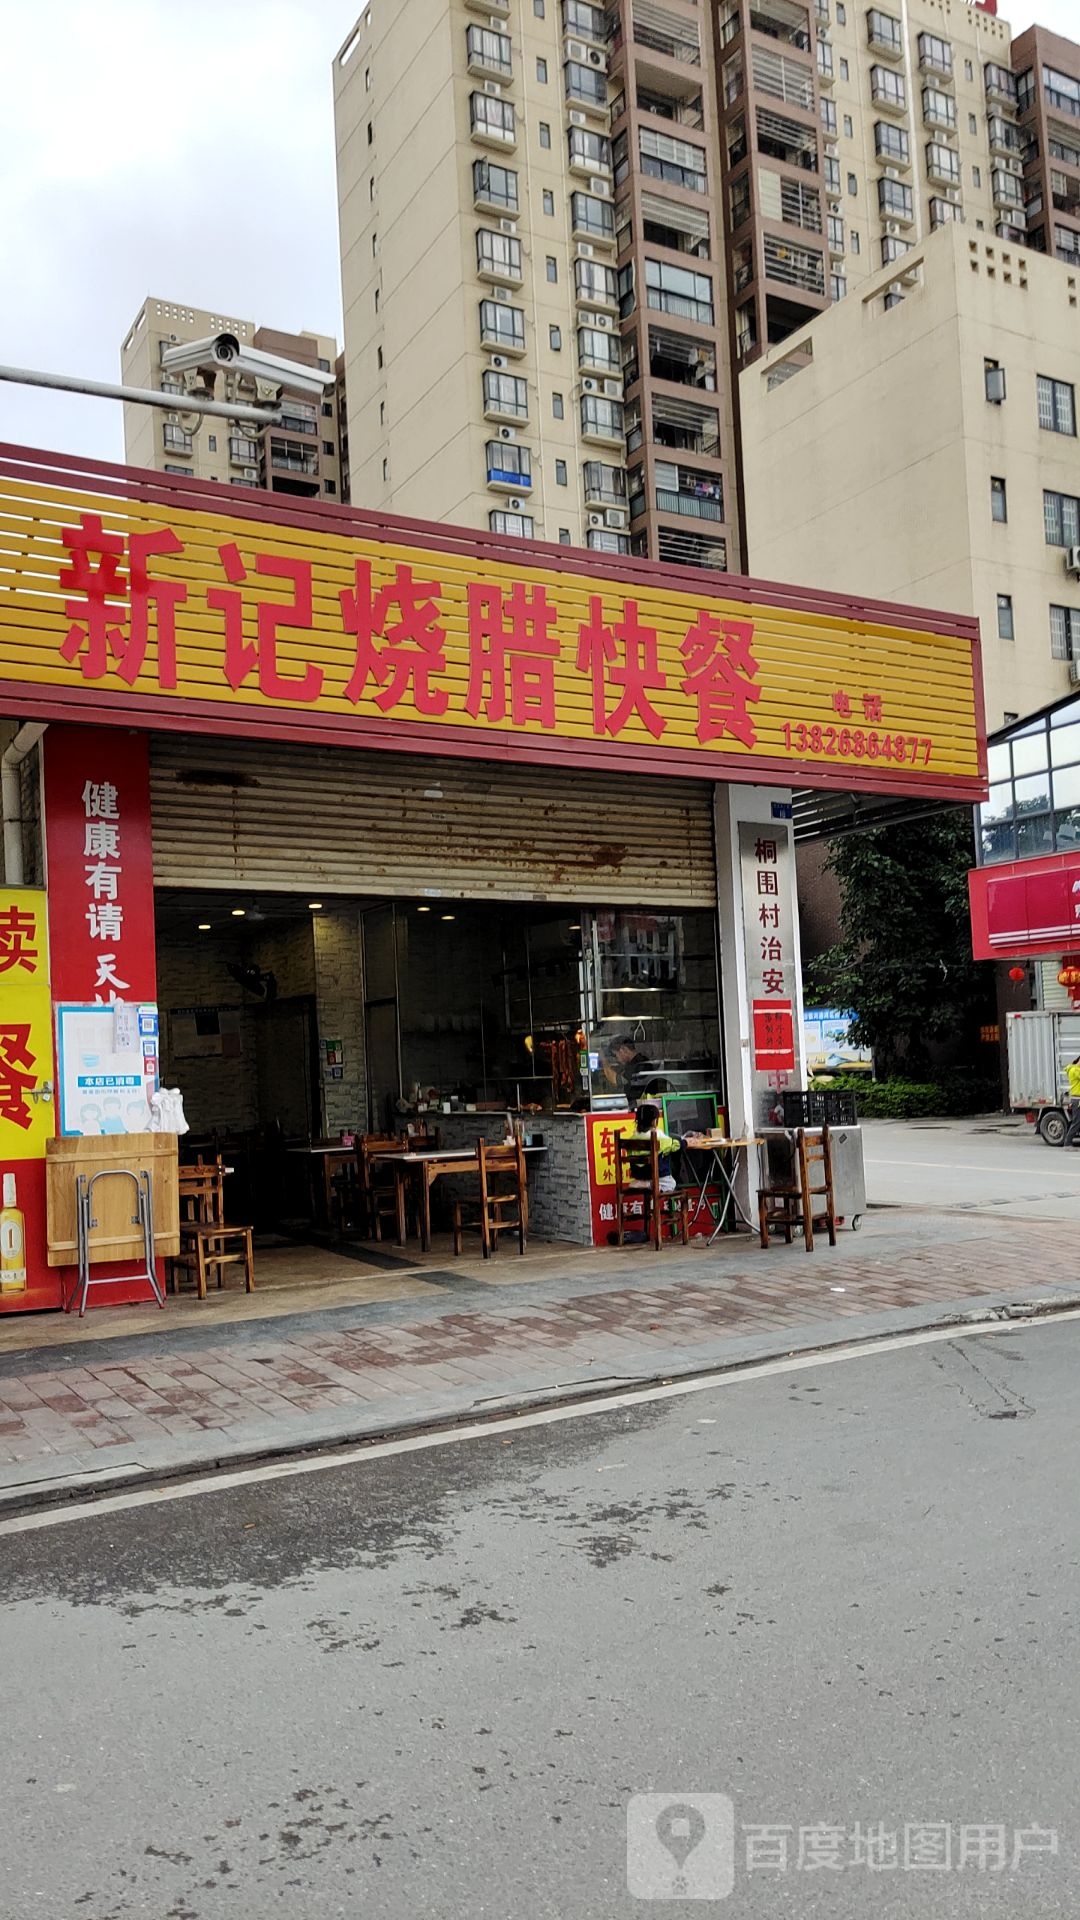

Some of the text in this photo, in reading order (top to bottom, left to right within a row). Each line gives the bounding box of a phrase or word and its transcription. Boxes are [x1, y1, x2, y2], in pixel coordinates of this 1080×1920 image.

[59, 513, 762, 749] 新记烧腊快餐
[831, 689, 883, 722] 电话
[780, 722, 933, 766] 13826864877
